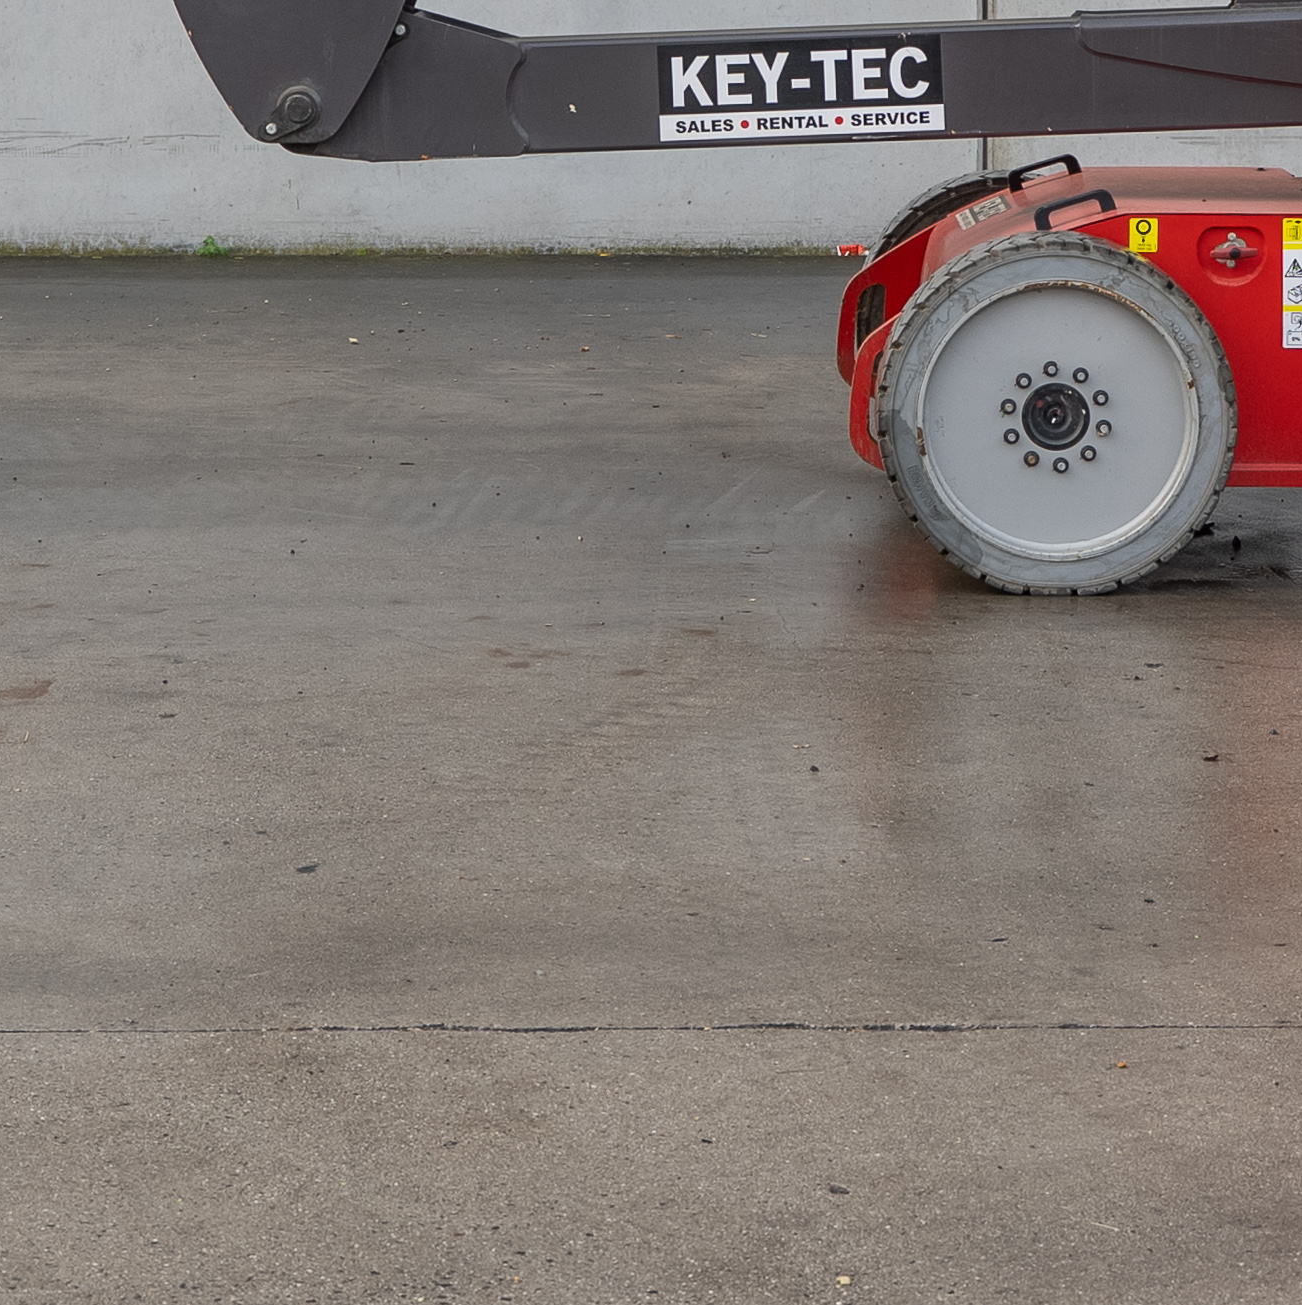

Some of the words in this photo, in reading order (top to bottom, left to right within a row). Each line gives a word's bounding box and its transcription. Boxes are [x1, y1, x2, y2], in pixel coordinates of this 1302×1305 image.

[670, 46, 930, 108] KEY-TEC
[675, 119, 734, 134] SALES
[757, 115, 829, 130] RENTAL
[850, 111, 930, 127] SERVICE
